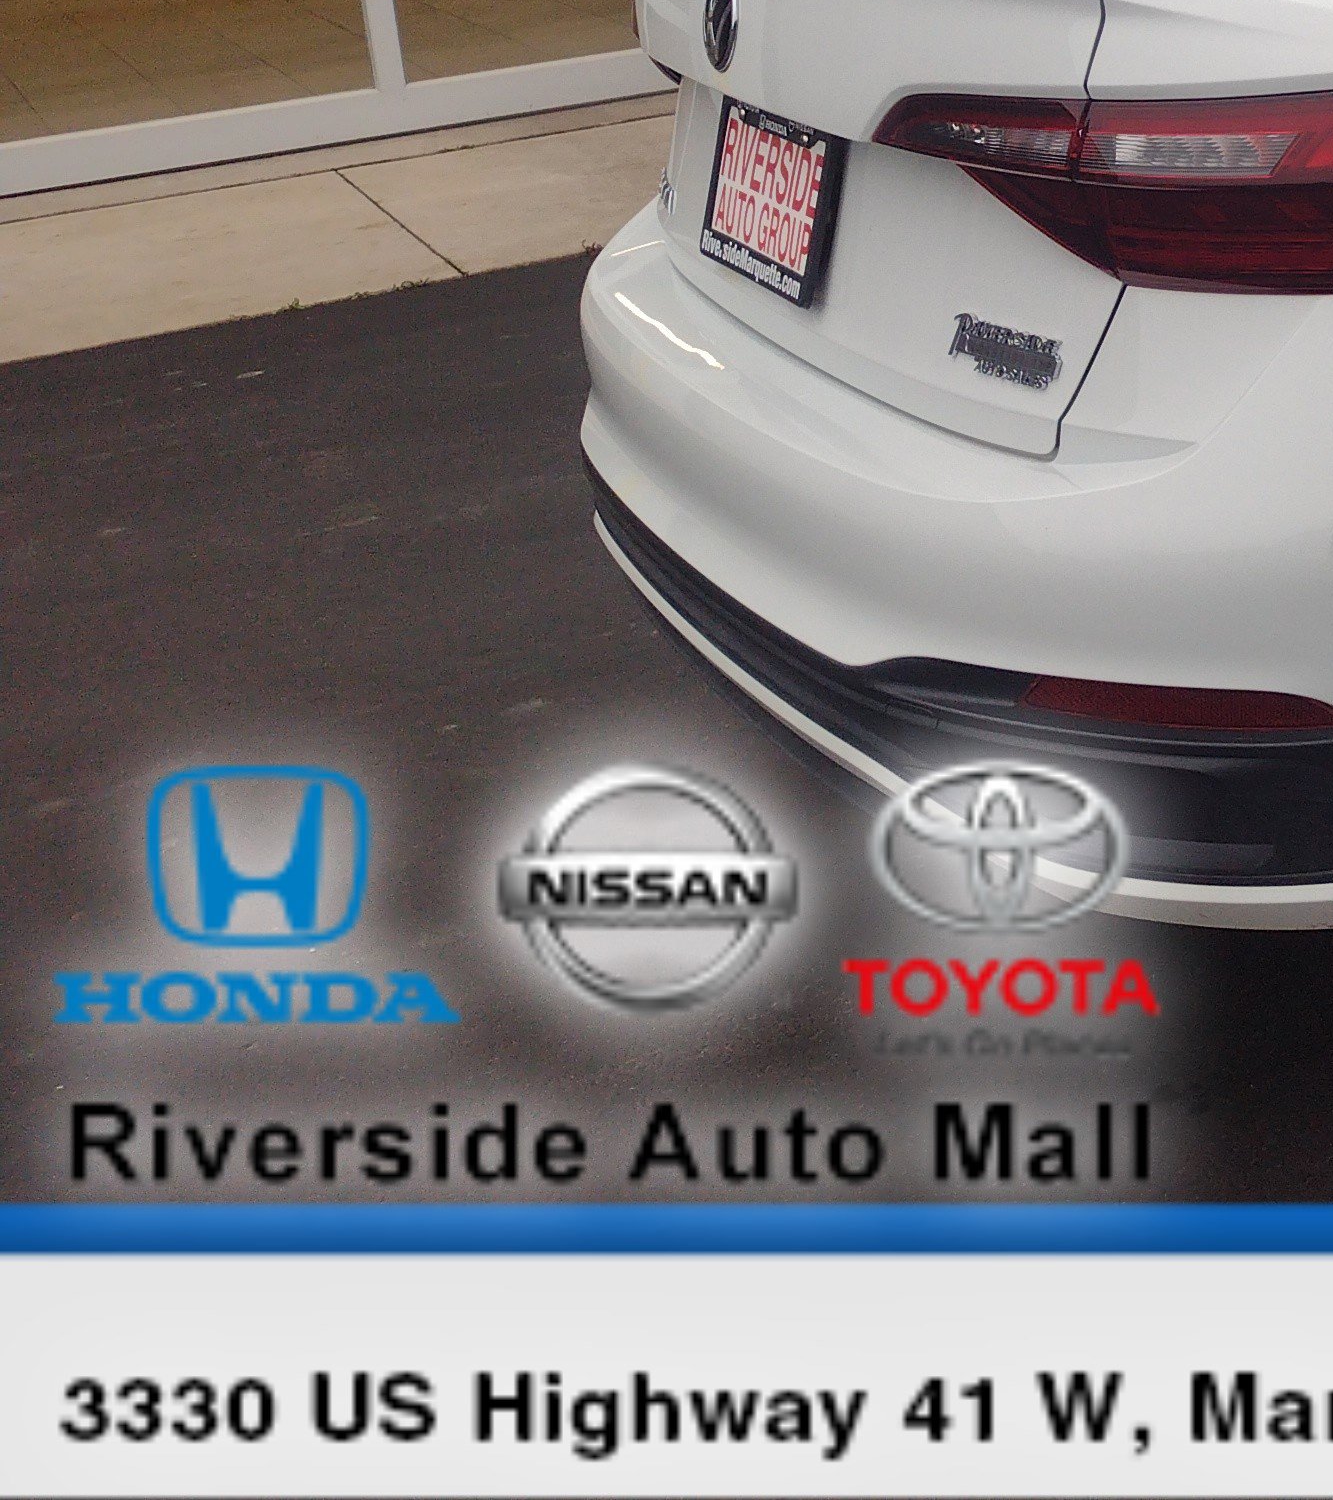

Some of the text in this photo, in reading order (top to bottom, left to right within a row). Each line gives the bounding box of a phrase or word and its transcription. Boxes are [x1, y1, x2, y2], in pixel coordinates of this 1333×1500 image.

[721, 117, 825, 220] RIVERSIDE
[714, 183, 756, 244] AUTO
[757, 201, 814, 271] GROUP
